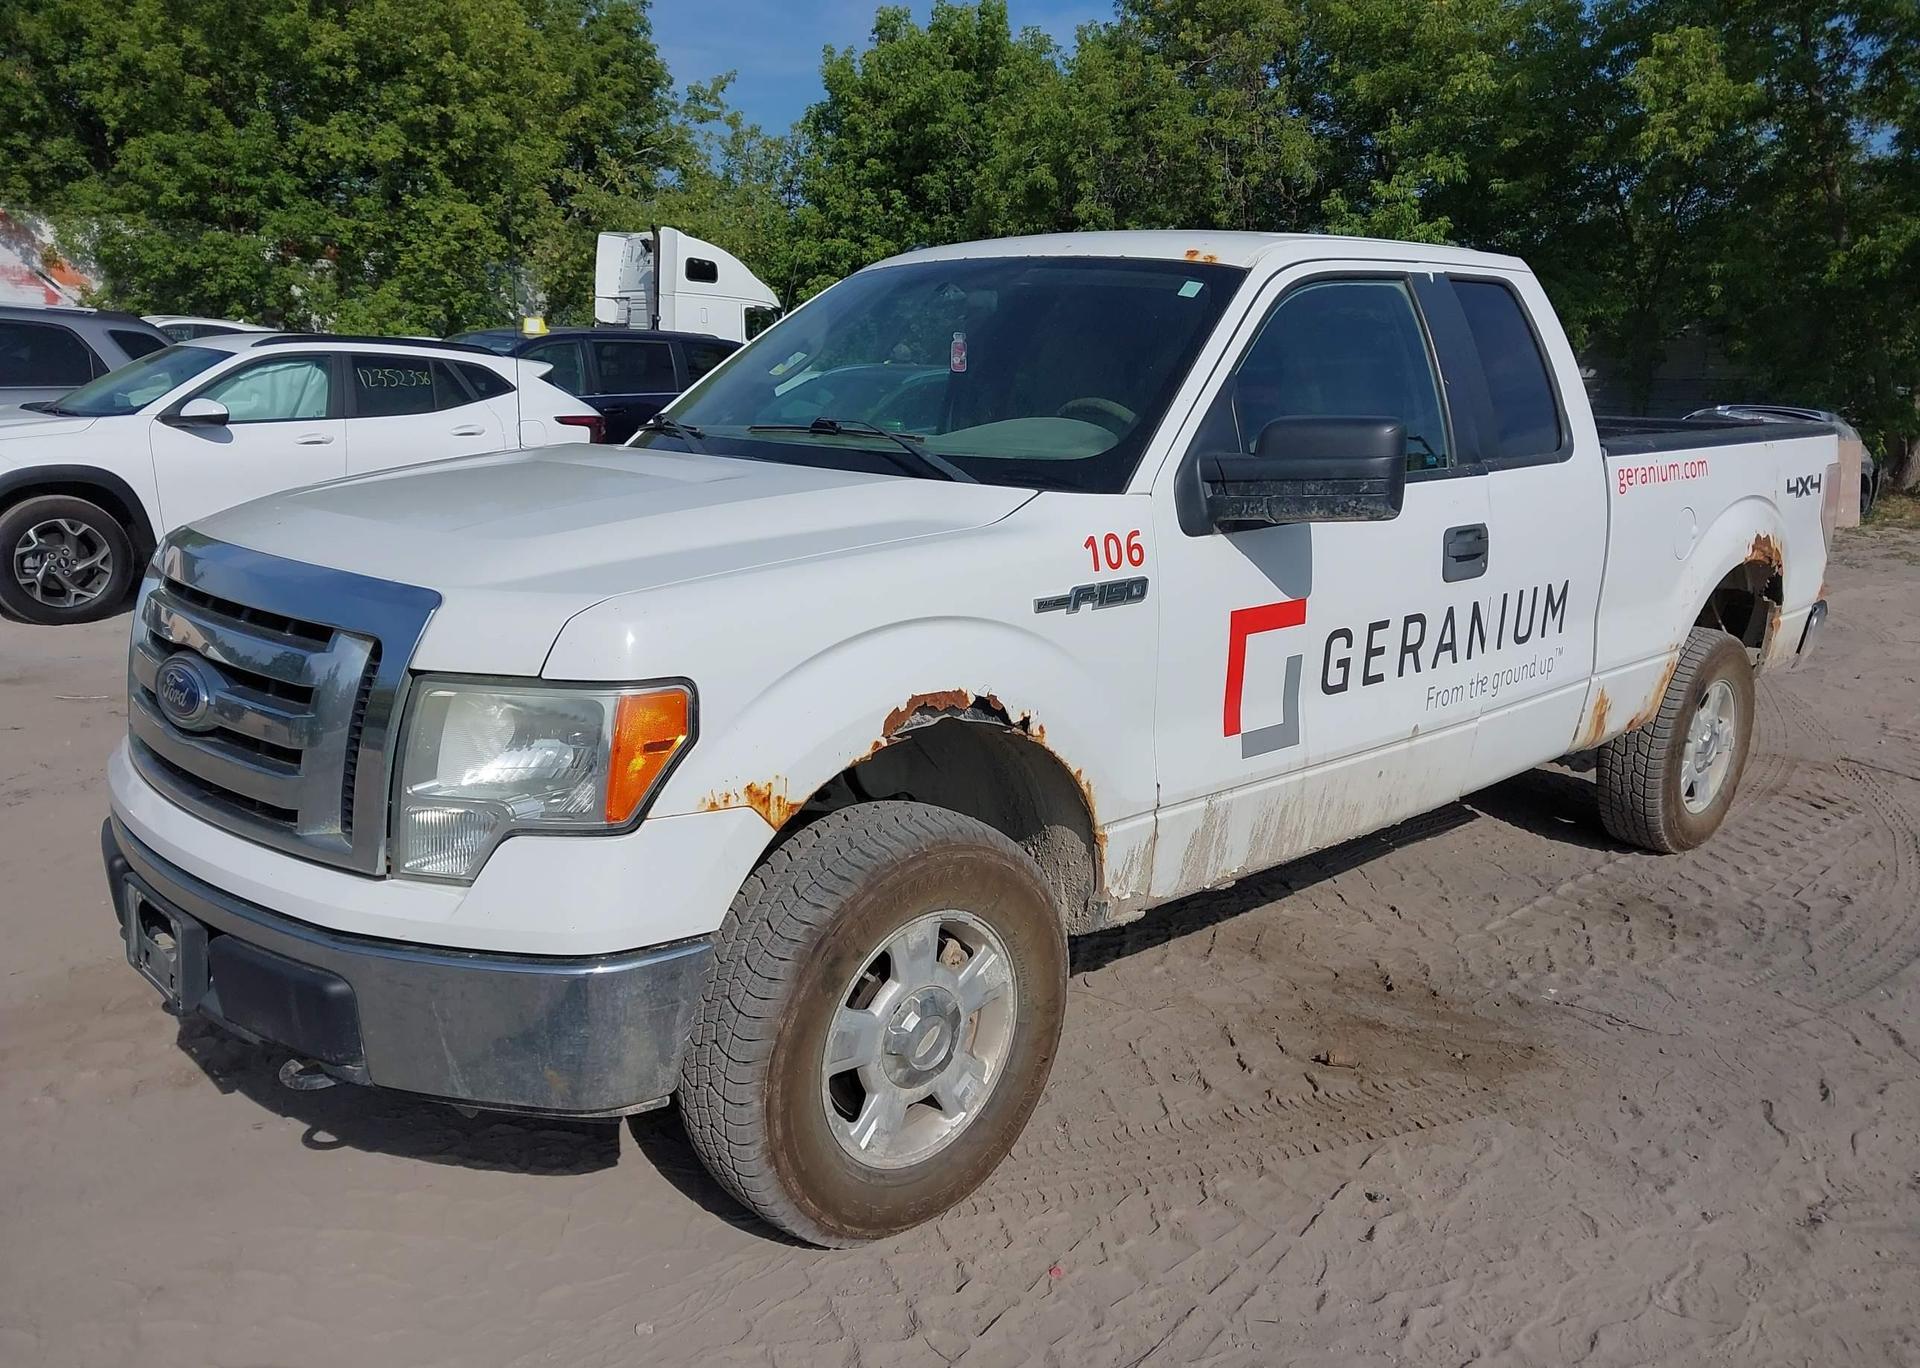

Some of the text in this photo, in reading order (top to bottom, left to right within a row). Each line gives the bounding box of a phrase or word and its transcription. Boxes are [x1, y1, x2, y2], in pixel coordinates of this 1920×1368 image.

[357, 368, 431, 388] 12352356
[1617, 459, 1709, 494] geranium.com
[1084, 530, 1144, 572] 106
[1067, 577, 1149, 614] F-150
[1321, 580, 1569, 695] GERANIUM
[162, 671, 190, 707] Ford
[1426, 685, 1464, 711] From
[1469, 673, 1488, 698] the
[1491, 654, 1537, 697] ground
